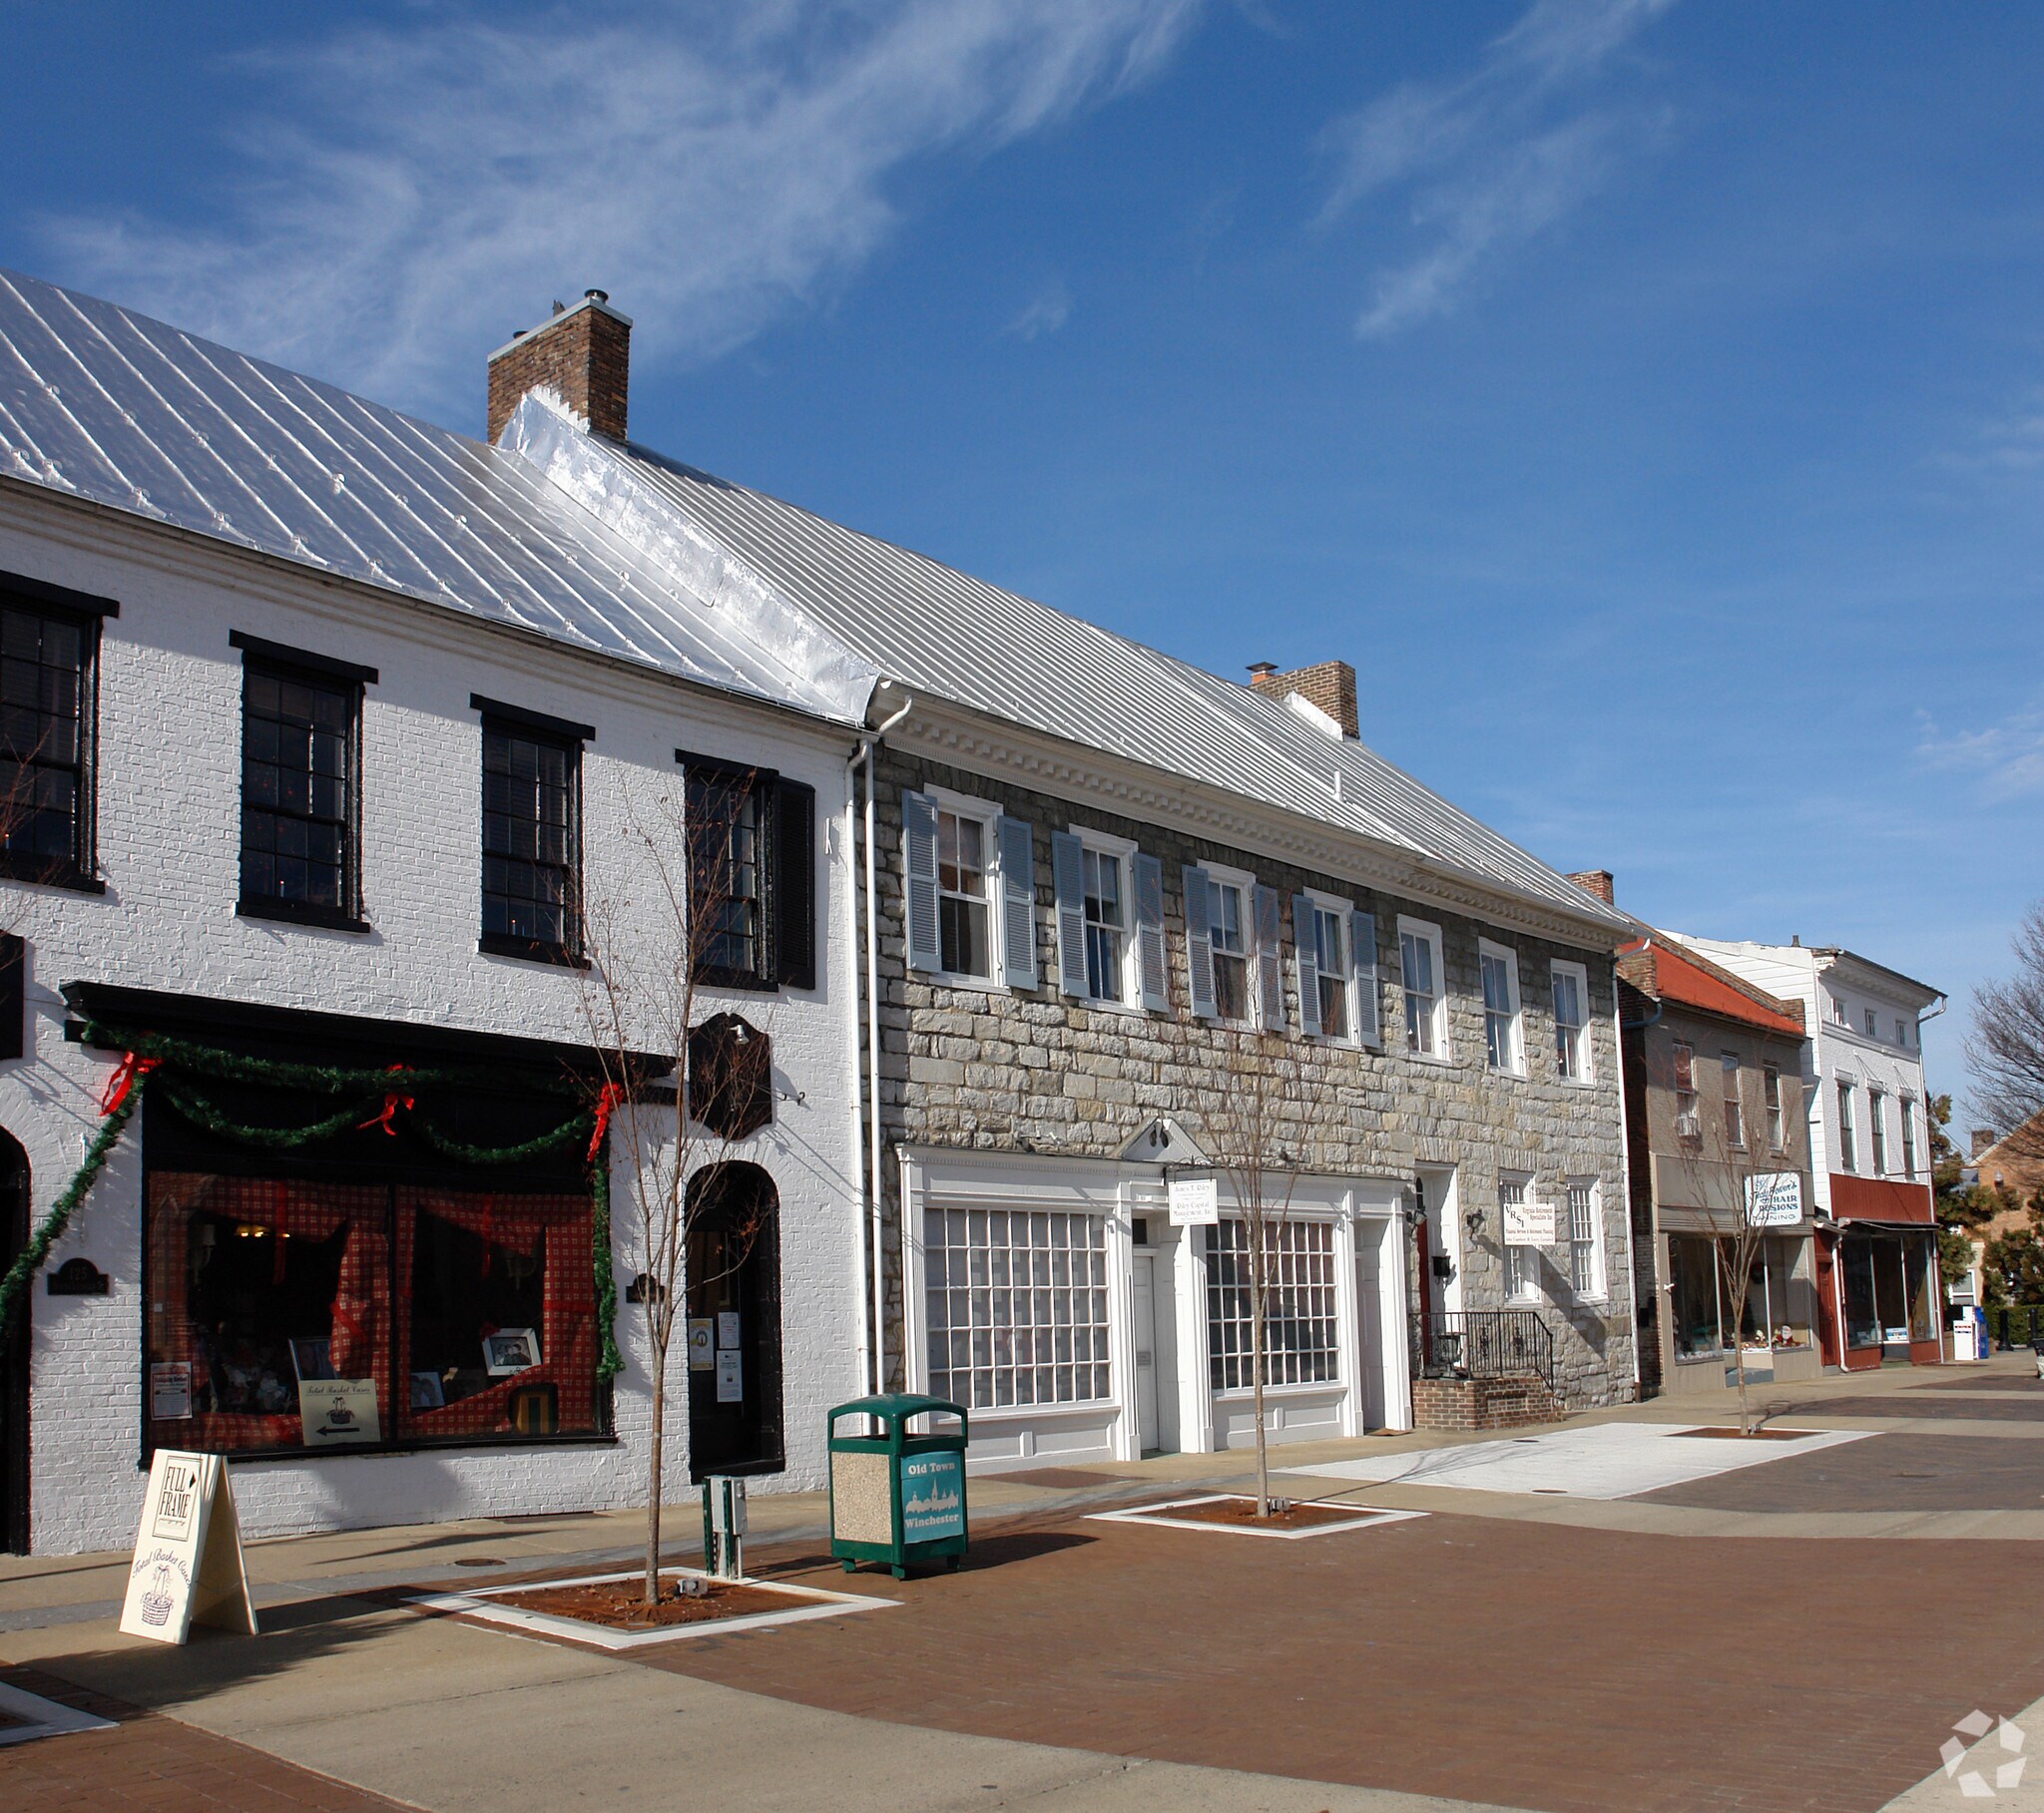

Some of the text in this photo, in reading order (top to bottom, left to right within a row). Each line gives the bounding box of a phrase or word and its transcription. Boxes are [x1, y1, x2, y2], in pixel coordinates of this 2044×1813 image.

[1773, 1194, 1797, 1203] HAIR
[907, 1462, 955, 1475] Old Town
[164, 1466, 187, 1493] FULL
[159, 1491, 191, 1519] FRAME
[904, 1514, 959, 1529] Winchester
[133, 1551, 154, 1579] Total
[153, 1548, 179, 1565] Basket
